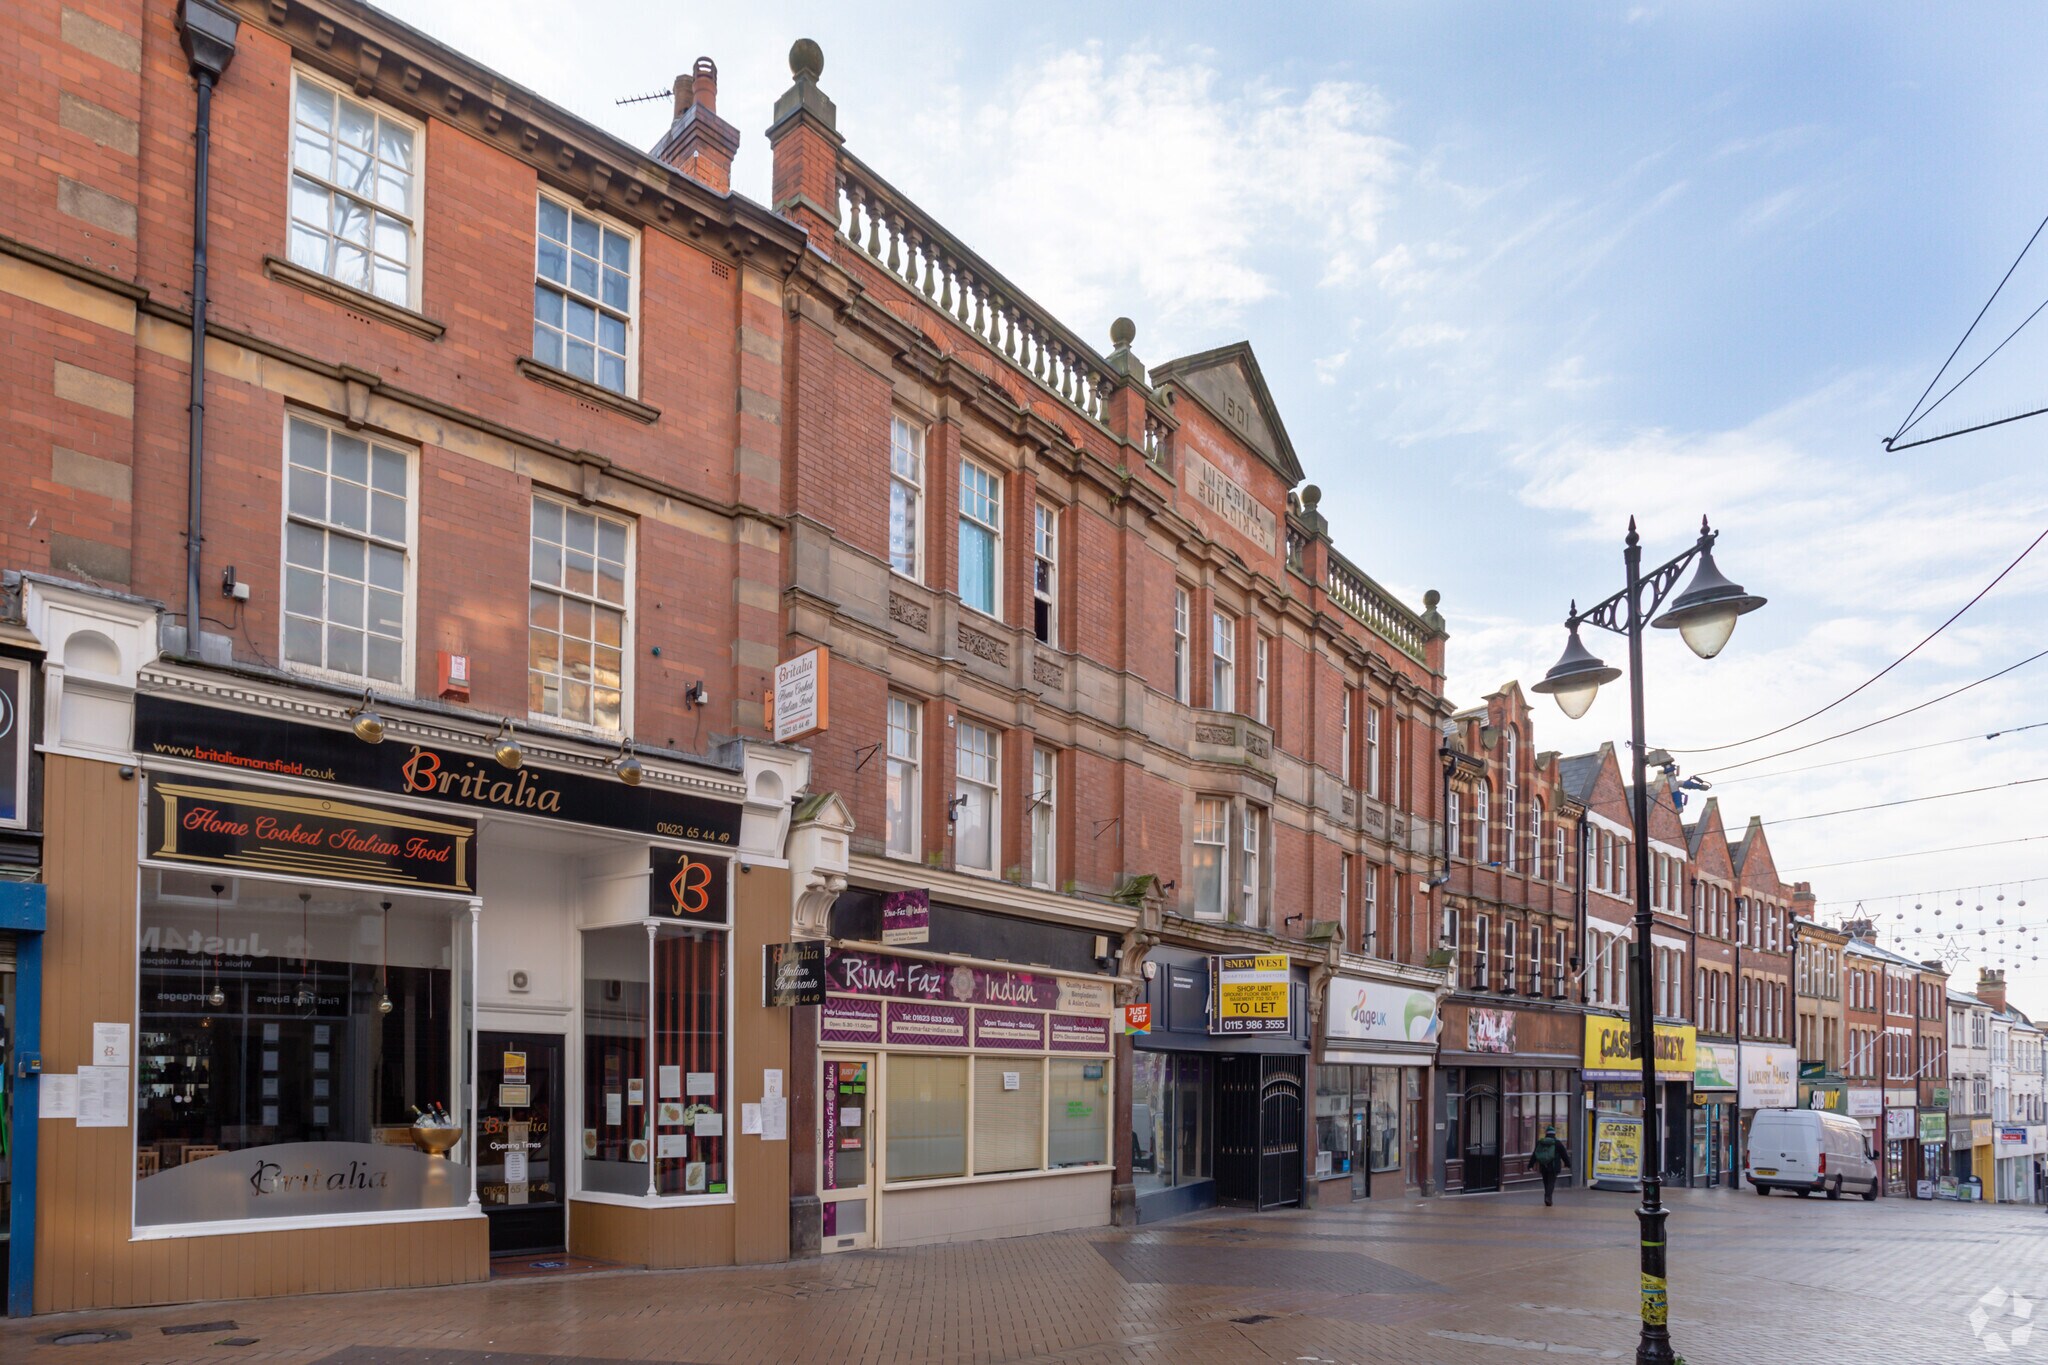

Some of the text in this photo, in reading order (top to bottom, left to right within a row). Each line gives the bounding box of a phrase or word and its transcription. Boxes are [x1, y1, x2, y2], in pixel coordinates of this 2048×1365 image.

[1222, 391, 1249, 433] 1901
[1202, 461, 1261, 523] IMPERIAL
[779, 657, 812, 684] Britalia
[778, 692, 814, 715] Italian Food
[153, 742, 336, 781] www.britaliamansfield.co.uk
[402, 745, 561, 813] Britalia
[183, 807, 452, 863] Home Cooked Italian Food
[656, 822, 730, 843] 01623 65 44 49
[778, 963, 809, 977] Italian
[1231, 958, 1284, 968] NEW WEST
[842, 958, 1038, 1004] Rima-Faz Indian
[824, 1008, 836, 1016] Fully
[1129, 1007, 1147, 1017] JUST
[1132, 1014, 1147, 1023] EAT
[1233, 1002, 1276, 1014] TO LET
[984, 1019, 997, 1027] Open
[997, 1020, 1015, 1028] Tuesday
[1224, 1020, 1285, 1030] 0115 986 3555
[1601, 1028, 1630, 1058] CAS
[825, 1064, 834, 1089] Indian
[1811, 1089, 1840, 1110] SUBWAY
[1606, 1123, 1636, 1133] CASH
[489, 1141, 541, 1151] Opening Times
[829, 1140, 834, 1149] to
[250, 1159, 389, 1197] Britalia
[483, 1185, 506, 1195] 01623
[538, 1183, 549, 1192] 49
